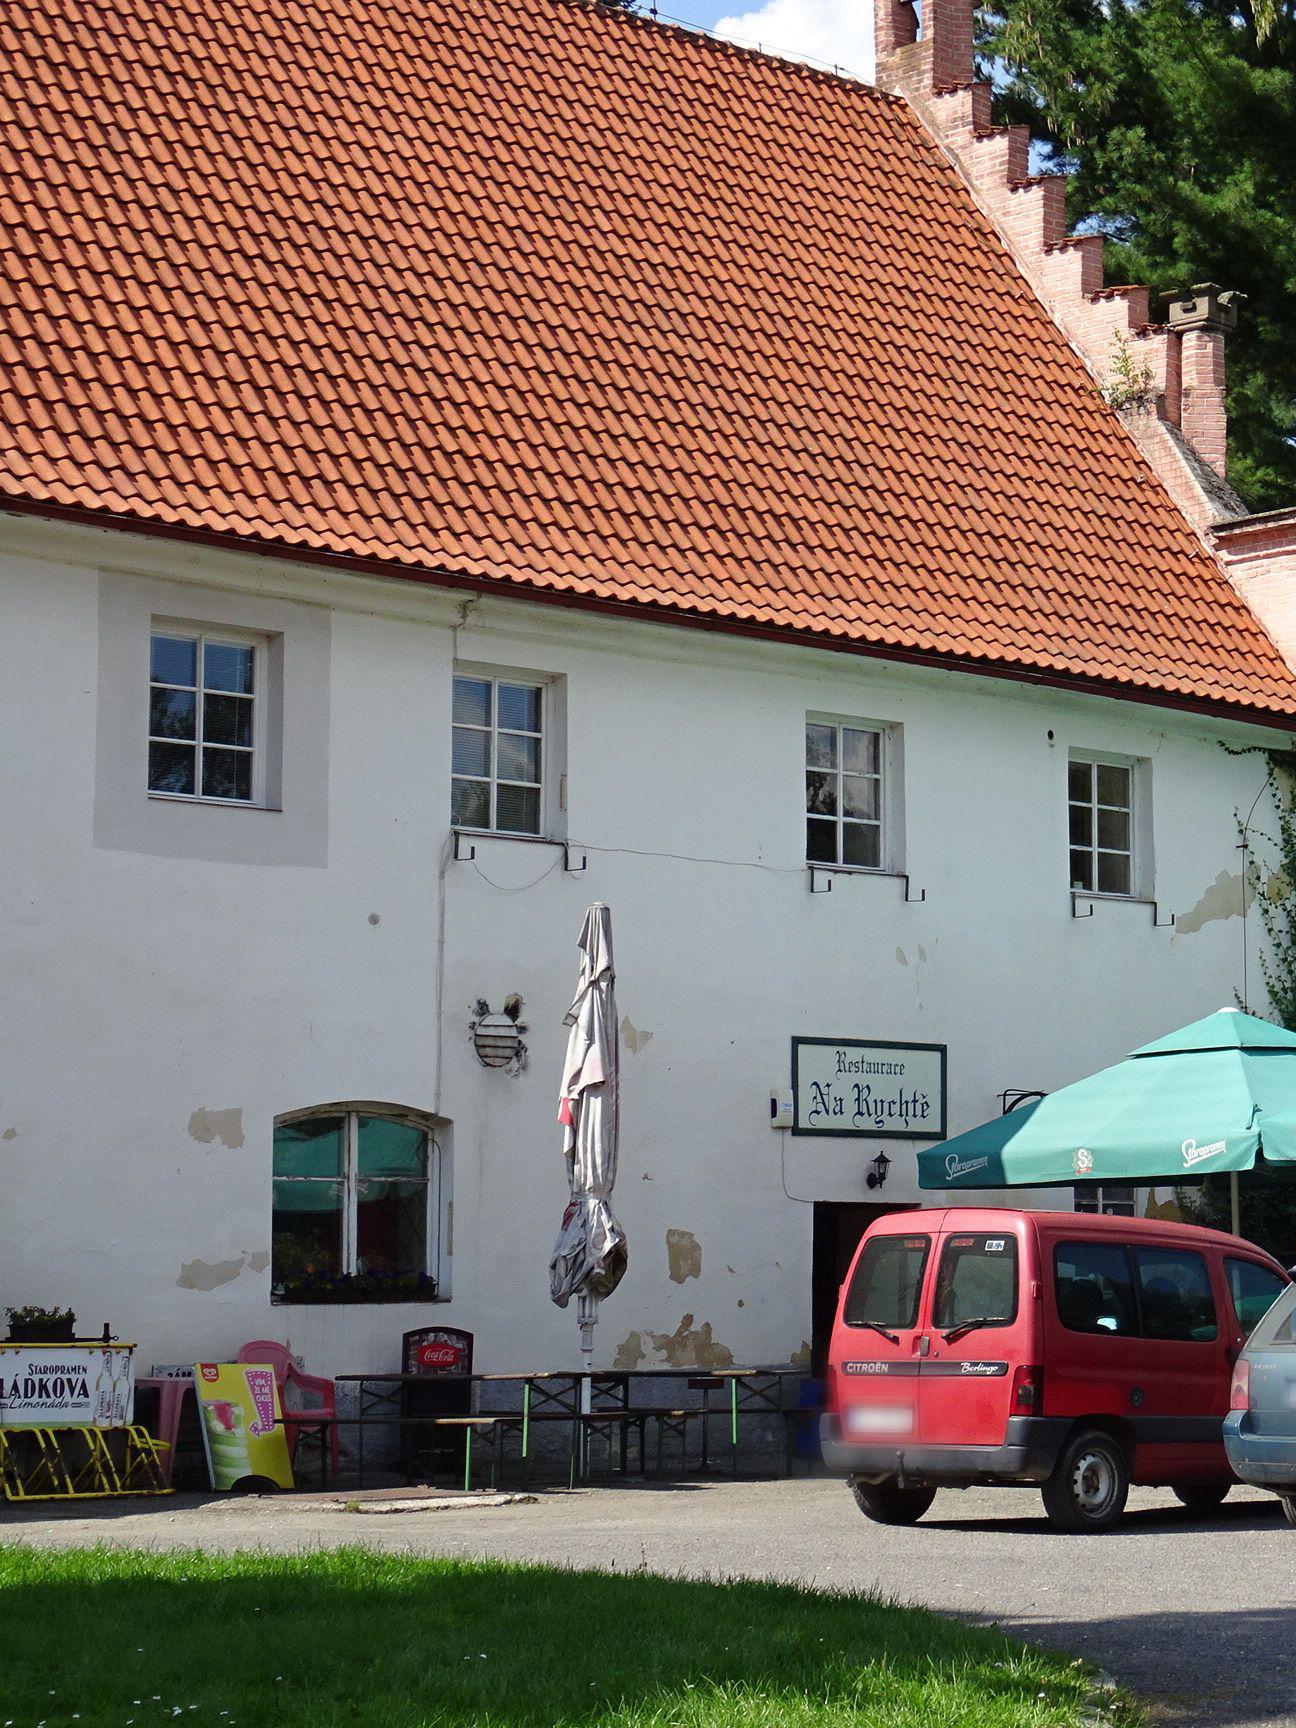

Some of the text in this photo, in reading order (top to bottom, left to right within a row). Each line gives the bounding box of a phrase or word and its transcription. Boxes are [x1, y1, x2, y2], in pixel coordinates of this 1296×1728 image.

[835, 1050, 906, 1080] Restaurace
[808, 1081, 931, 1129] Na Rychtě
[1181, 1138, 1227, 1168] Staropramen
[28, 1363, 88, 1376] STAROPRAMEN
[846, 1362, 889, 1373] CITROËN
[960, 1361, 999, 1374] Berlingo
[8, 1393, 70, 1410] Limonáda
